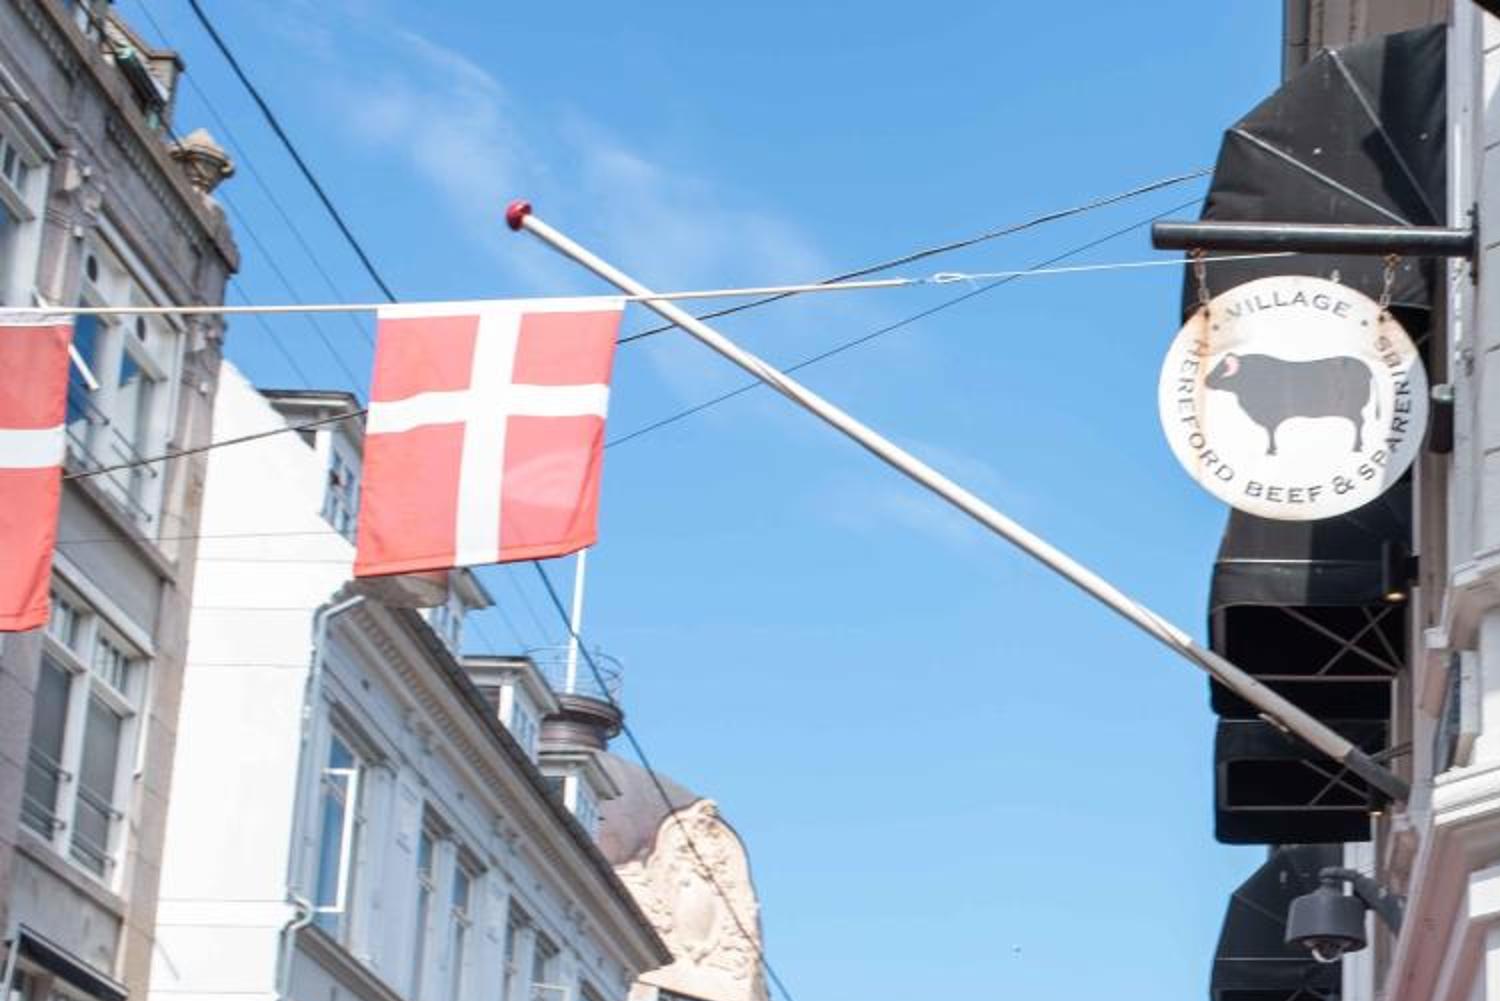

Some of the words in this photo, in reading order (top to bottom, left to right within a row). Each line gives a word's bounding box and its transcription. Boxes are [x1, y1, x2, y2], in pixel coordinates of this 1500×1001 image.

[1226, 290, 1351, 319] VILLAGE
[1176, 338, 1236, 483] HEREFORD
[1244, 480, 1323, 504] BEEF
[1332, 475, 1355, 496] &
[1357, 335, 1411, 482] SPARERIBS
